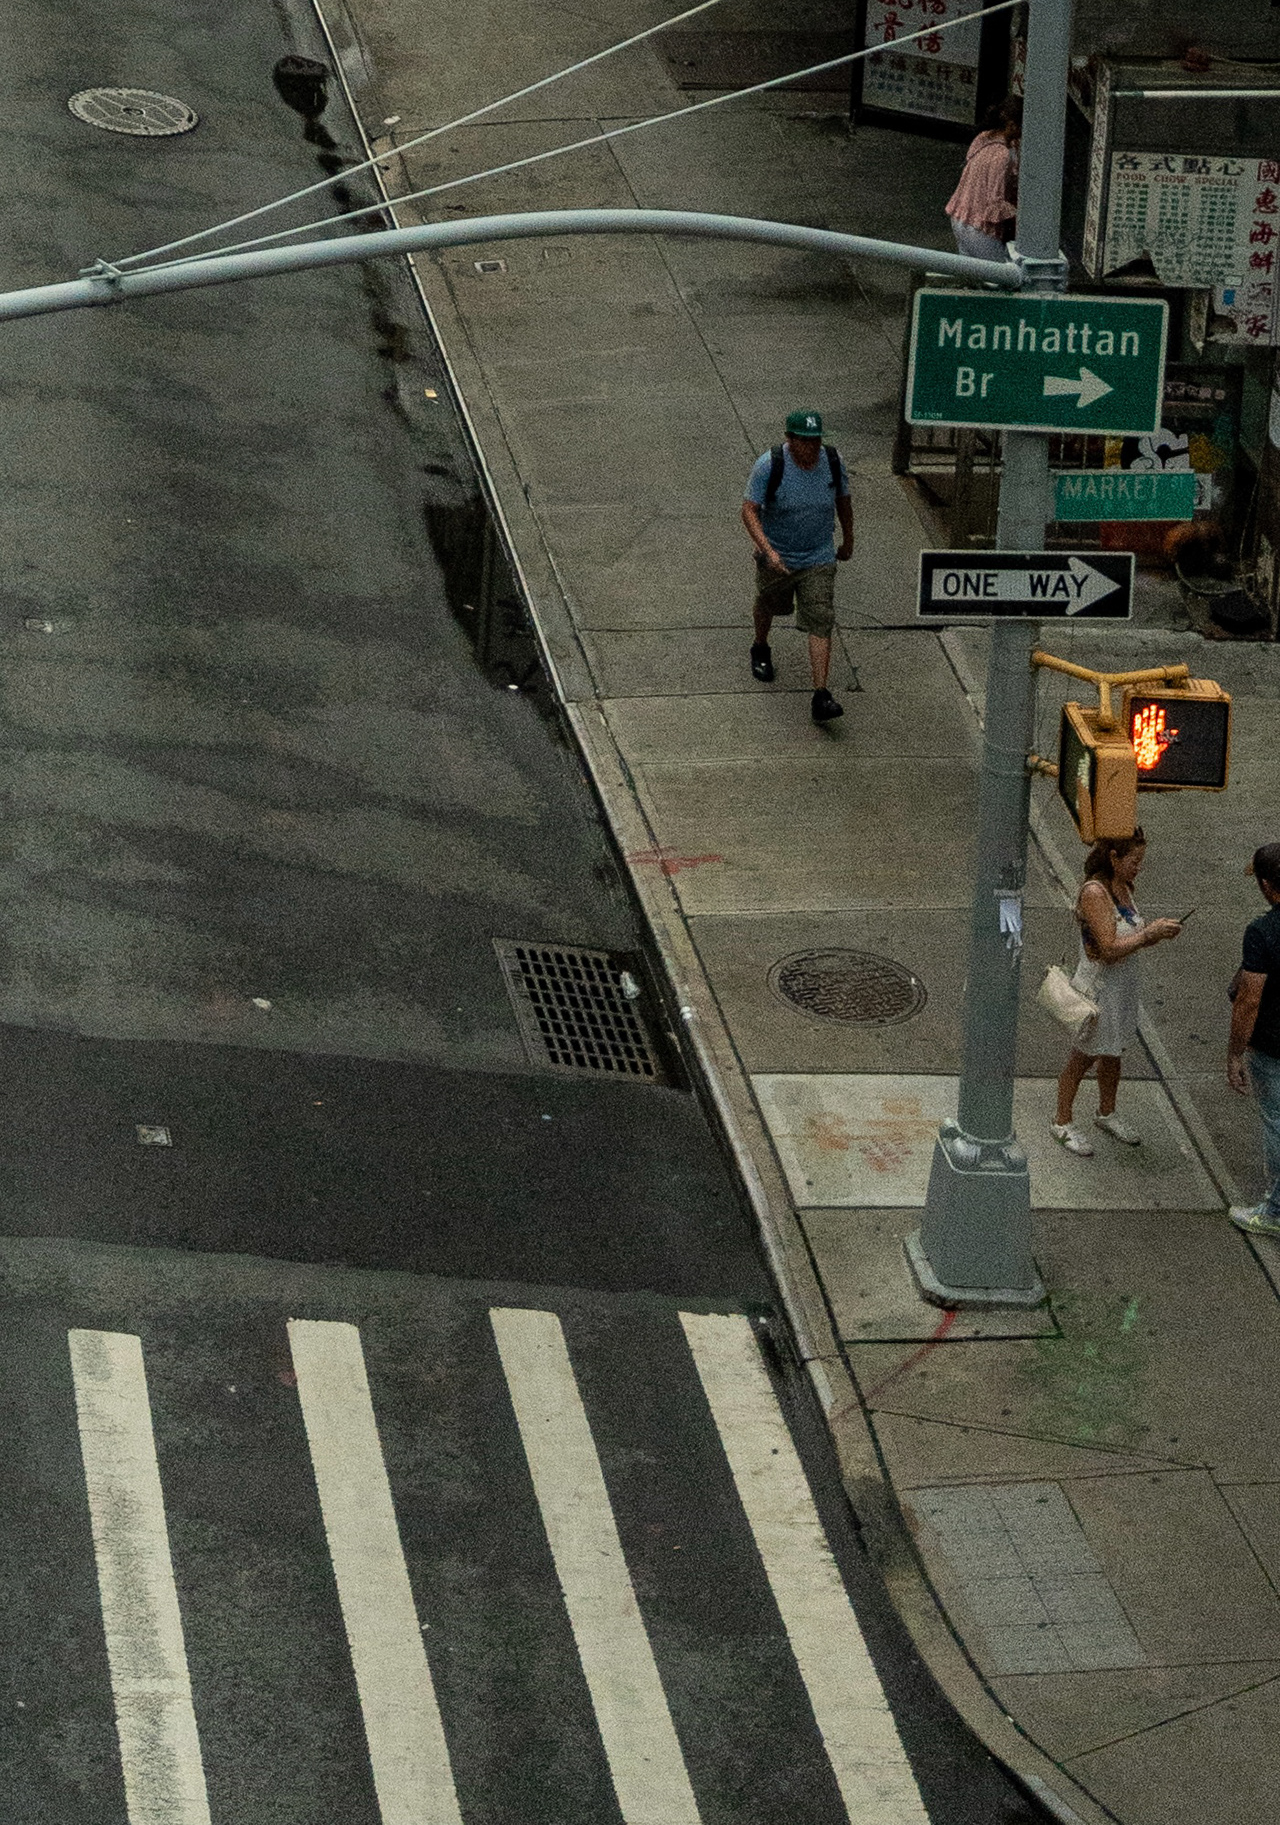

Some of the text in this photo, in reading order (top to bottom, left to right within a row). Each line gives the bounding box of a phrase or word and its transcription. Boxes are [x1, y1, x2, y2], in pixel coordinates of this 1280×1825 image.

[1116, 153, 1245, 176] 各式點心
[937, 317, 1141, 358] Manhattan
[955, 366, 995, 399] Br
[1062, 474, 1161, 500] MARKET
[942, 572, 1090, 598] ONE WAY
